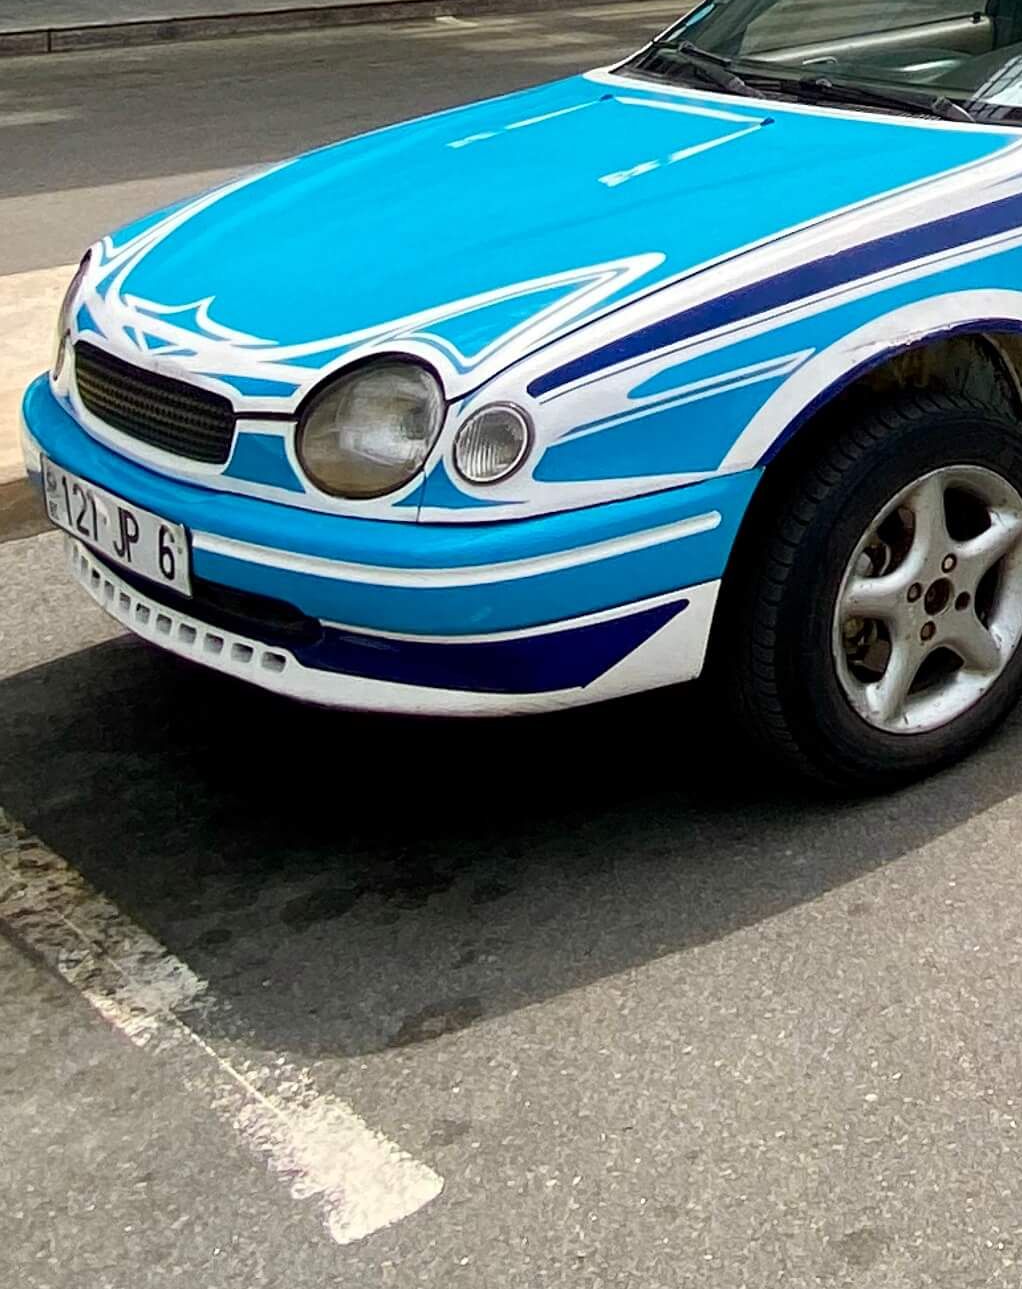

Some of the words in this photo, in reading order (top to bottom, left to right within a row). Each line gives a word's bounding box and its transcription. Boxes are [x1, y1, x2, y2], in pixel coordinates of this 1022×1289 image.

[62, 475, 98, 542] 121
[113, 506, 140, 563] JP
[158, 524, 176, 581] 6
